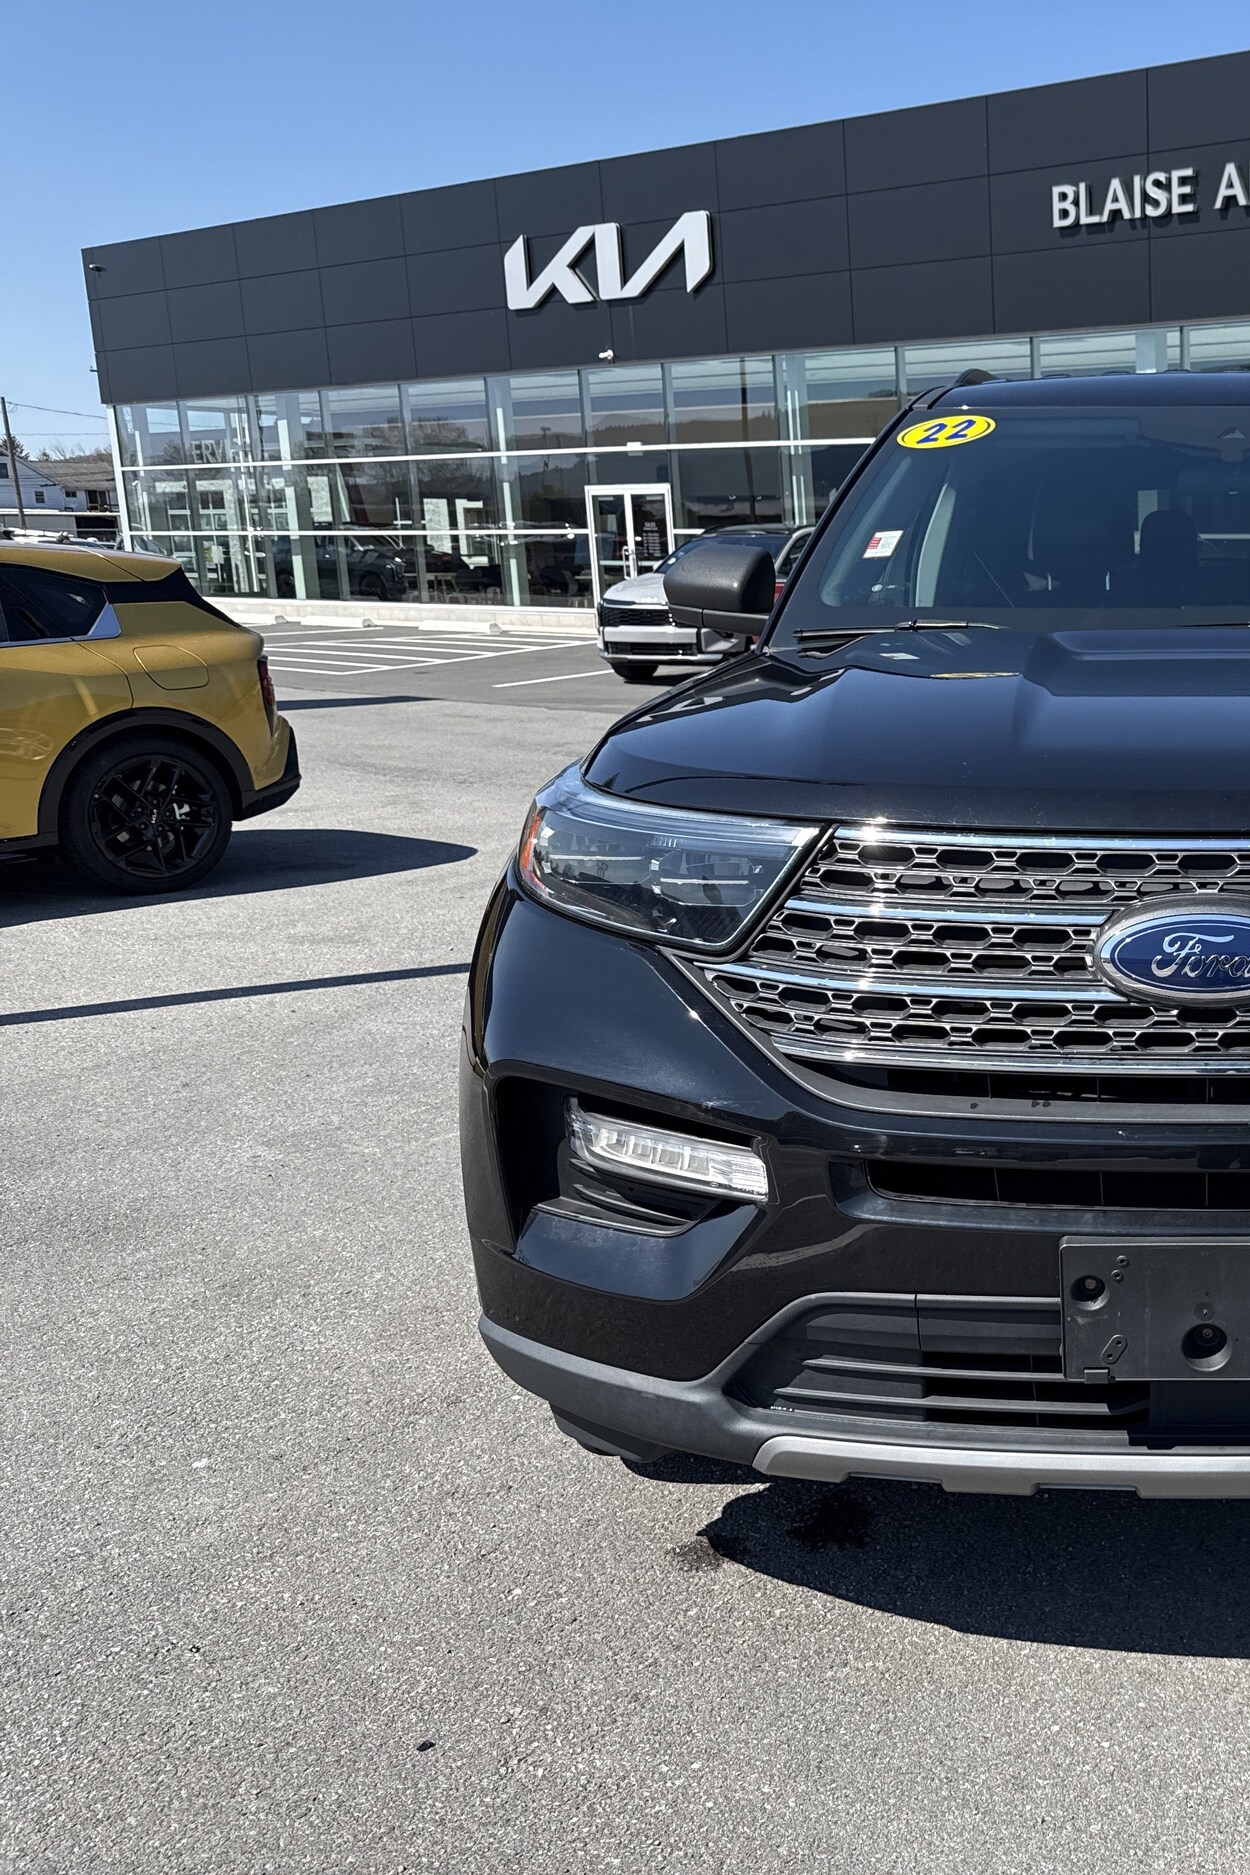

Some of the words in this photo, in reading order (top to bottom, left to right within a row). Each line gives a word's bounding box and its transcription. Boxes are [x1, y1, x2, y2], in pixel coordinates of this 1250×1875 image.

[1051, 167, 1195, 228] BLAISE
[504, 210, 712, 311] KIA
[916, 419, 976, 444] 22
